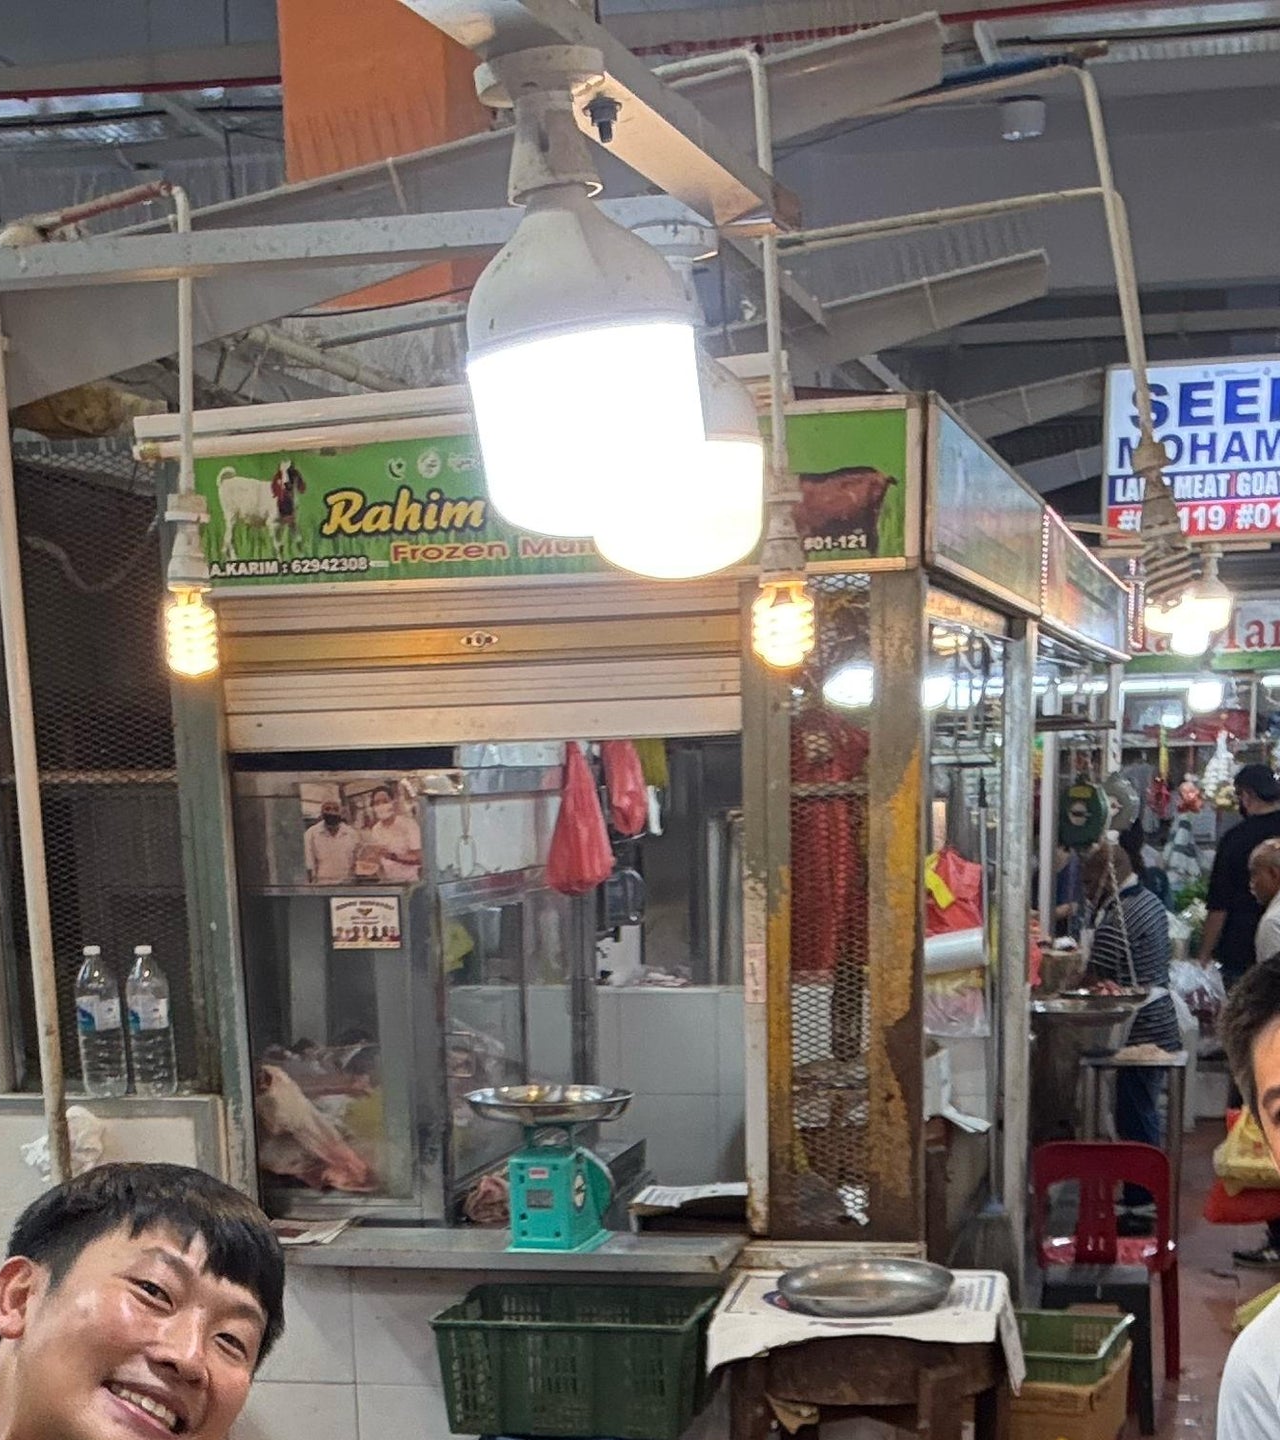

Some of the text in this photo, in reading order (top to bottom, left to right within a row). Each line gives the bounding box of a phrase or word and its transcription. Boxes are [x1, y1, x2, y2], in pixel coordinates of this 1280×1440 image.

[1174, 472, 1230, 498] MEAT
[322, 488, 486, 536] Rahim
[392, 540, 506, 563] Frozen
[291, 557, 367, 574] 62942308
